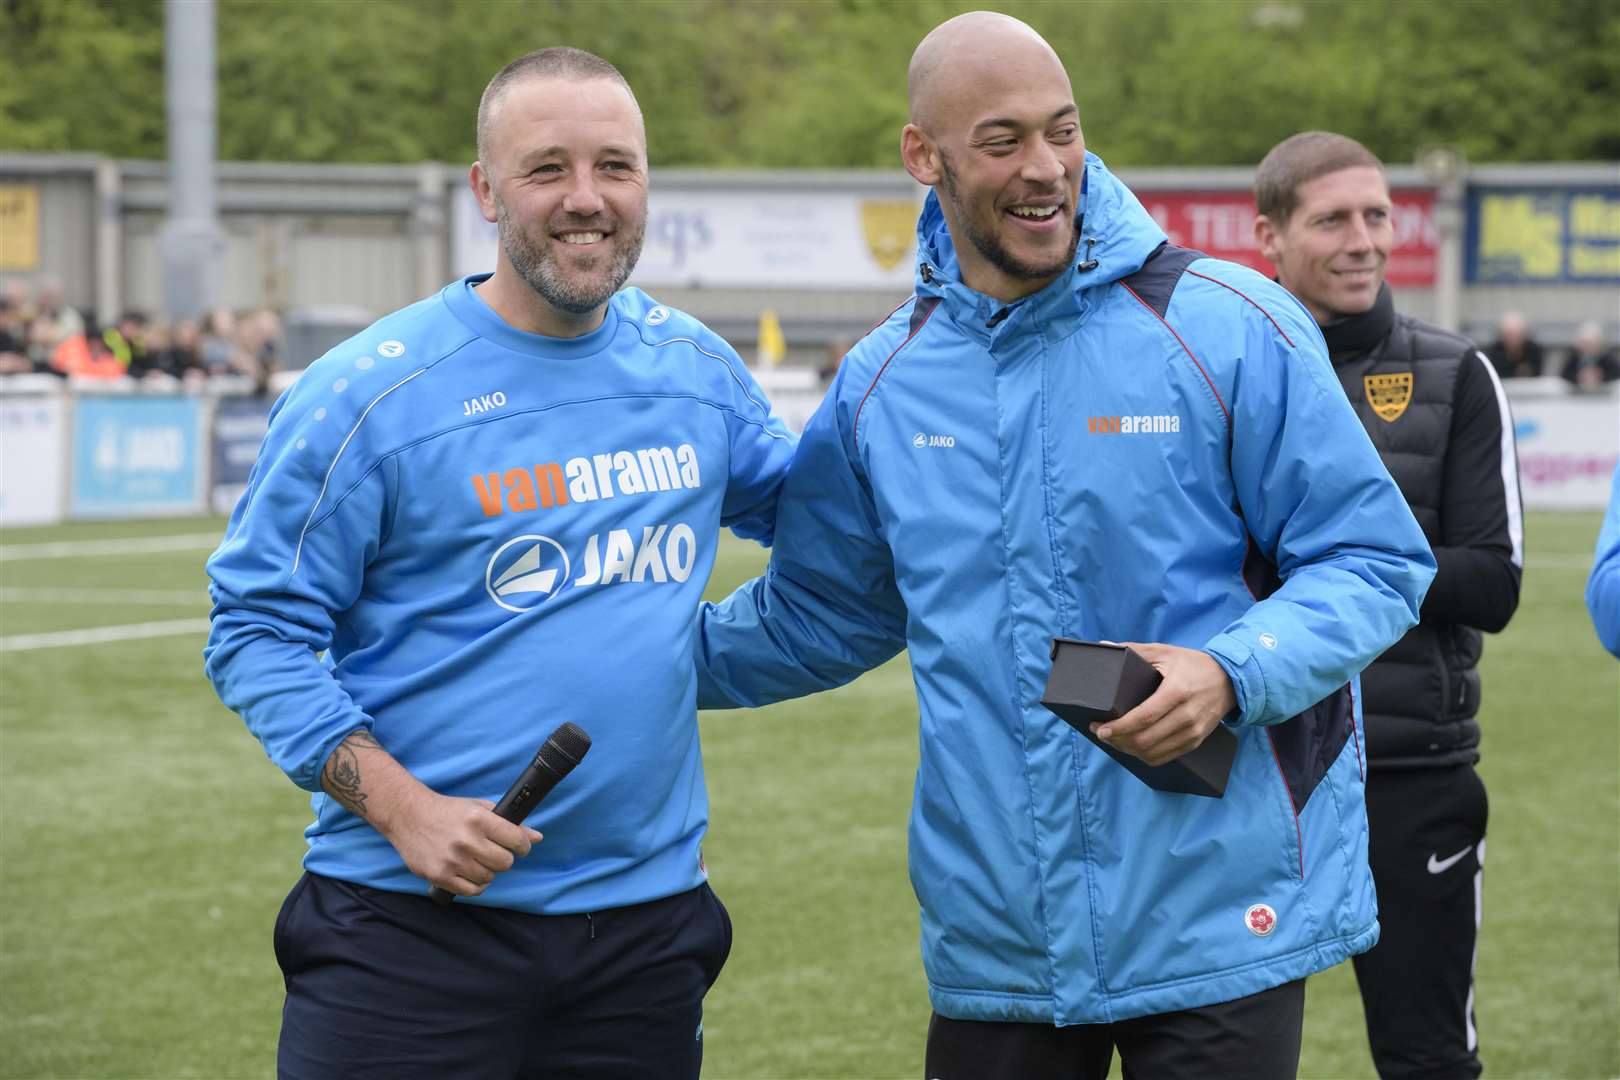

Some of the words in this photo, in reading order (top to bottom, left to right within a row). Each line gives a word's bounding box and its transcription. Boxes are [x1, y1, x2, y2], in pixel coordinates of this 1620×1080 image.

[463, 391, 507, 416] JAKO
[1087, 415, 1181, 434] vanarama
[928, 436, 956, 448] JAKO
[471, 443, 701, 517] vanarama
[574, 523, 697, 586] JAKO
